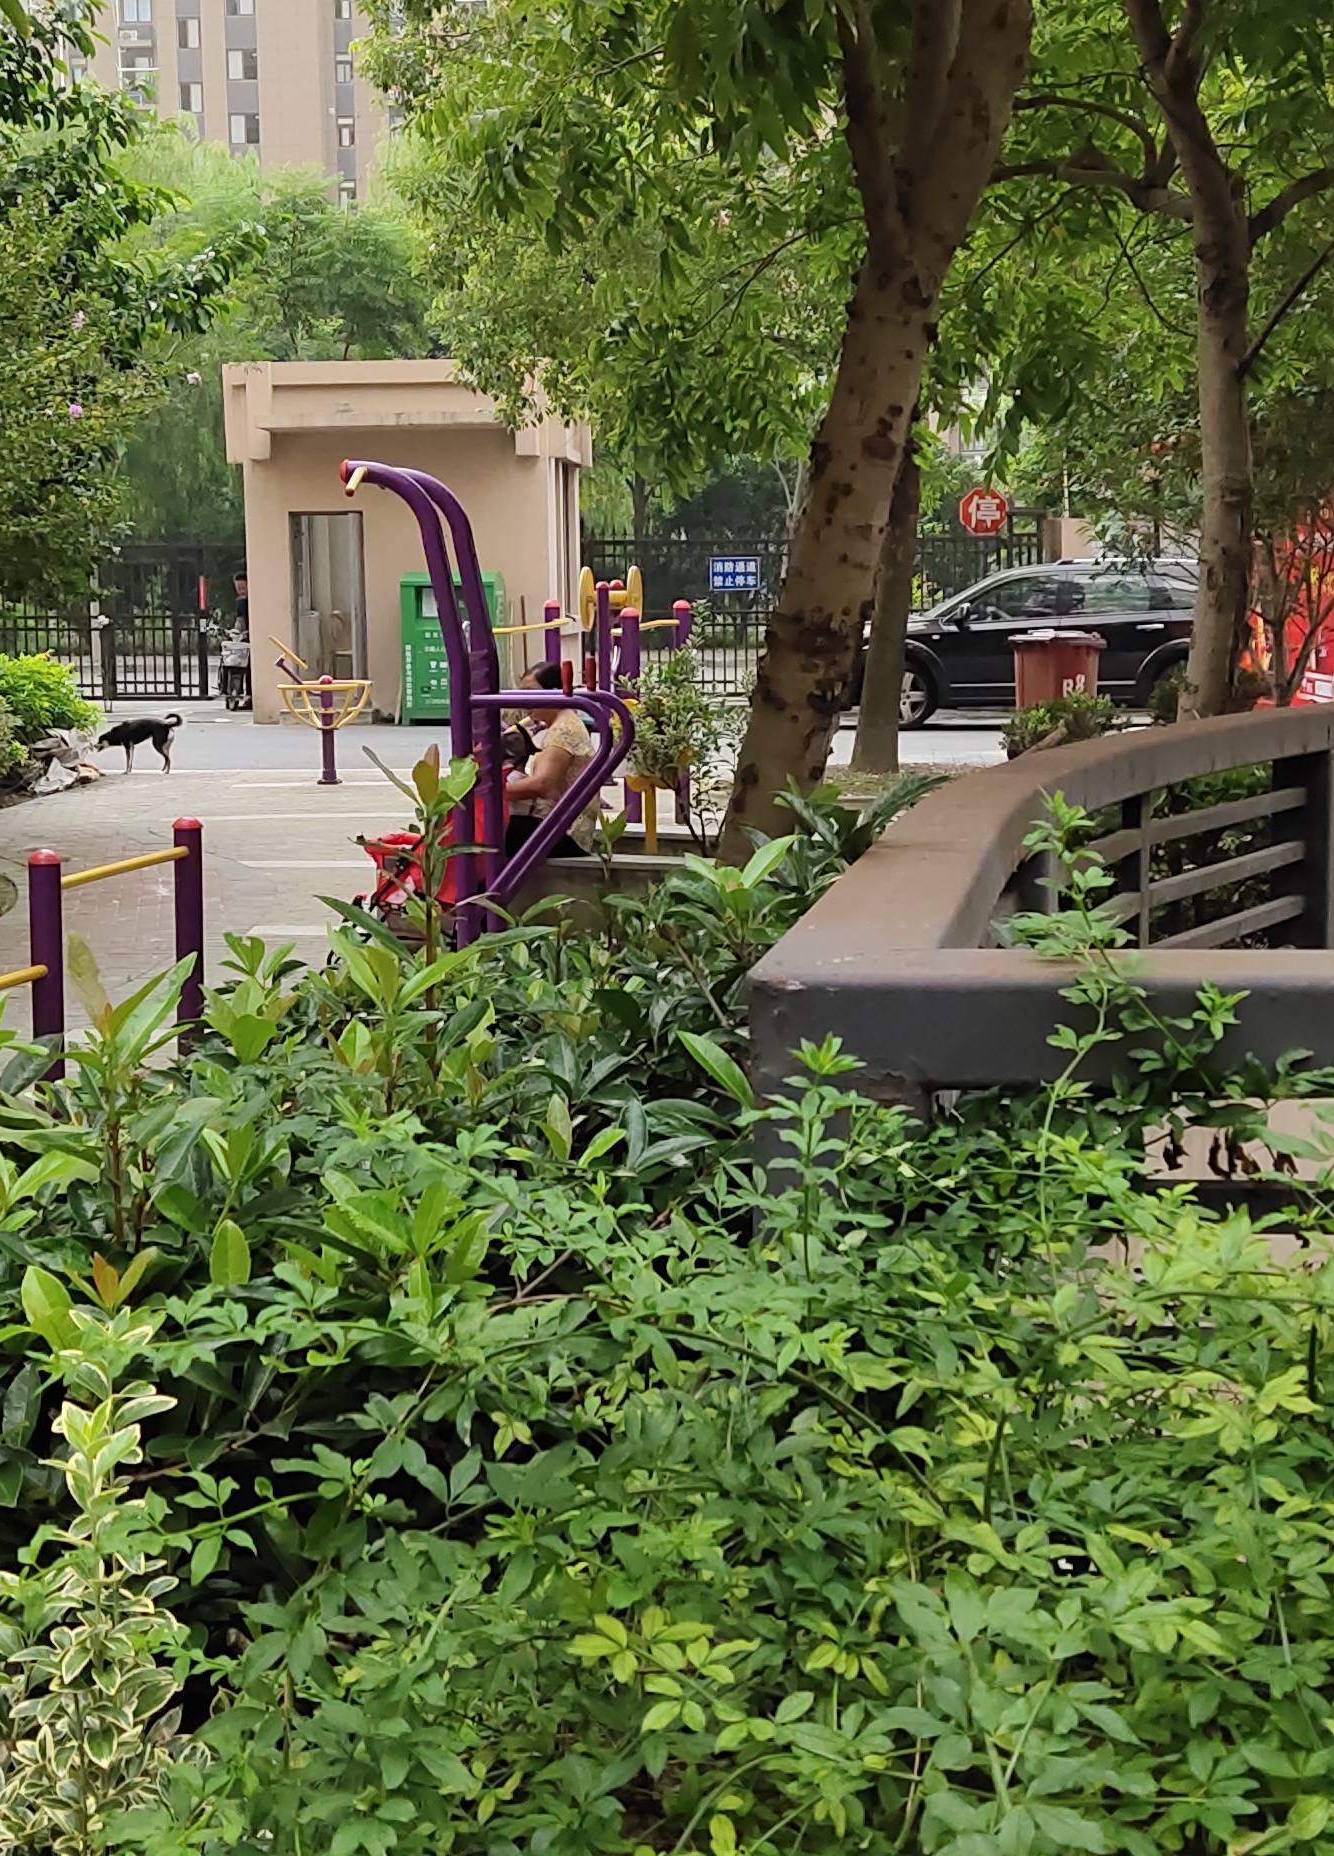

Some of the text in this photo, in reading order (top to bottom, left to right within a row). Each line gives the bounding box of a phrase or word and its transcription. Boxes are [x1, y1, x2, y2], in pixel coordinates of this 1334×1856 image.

[968, 495, 1001, 529] 停
[713, 561, 757, 573] 消防通道
[713, 575, 757, 587] 禁止停车
